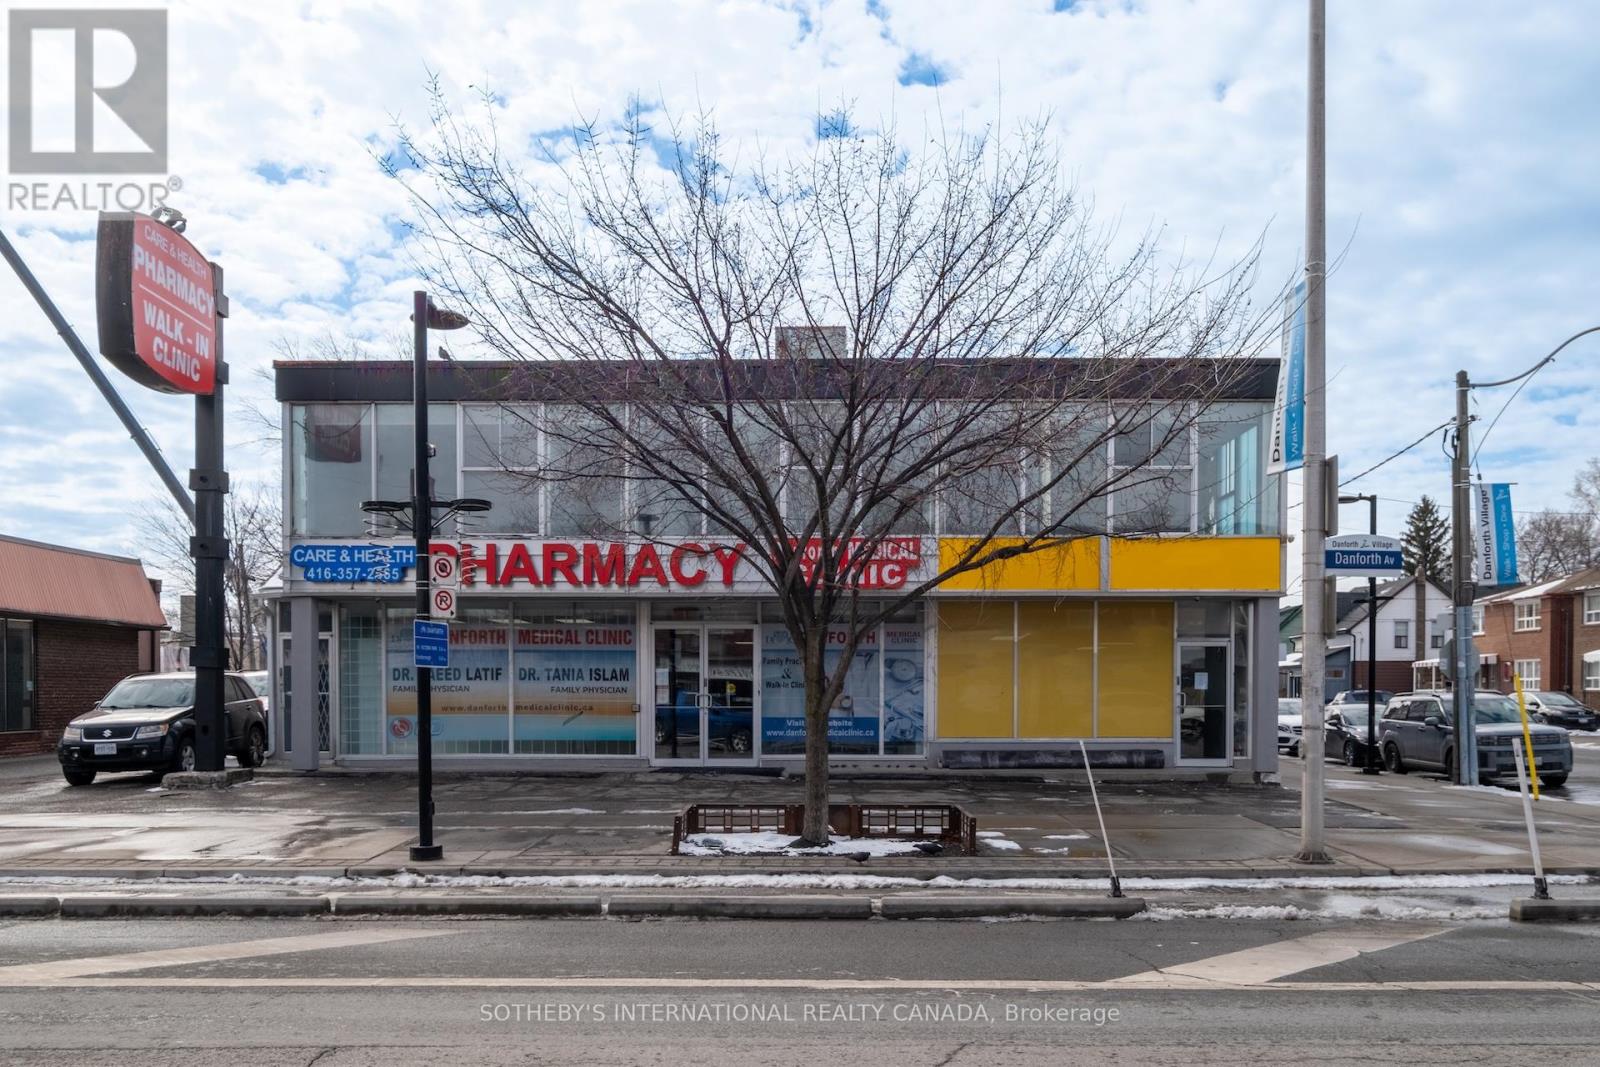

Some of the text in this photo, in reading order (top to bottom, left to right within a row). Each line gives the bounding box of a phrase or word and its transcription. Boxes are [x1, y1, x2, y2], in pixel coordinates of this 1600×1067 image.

[144, 225, 169, 253] CARE
[177, 248, 207, 280] HEALTH
[133, 243, 214, 318] PHARMACY
[143, 300, 184, 345] WALK
[195, 332, 208, 359] IN
[153, 336, 200, 382] CLINIC
[1481, 489, 1491, 527] Village
[1371, 541, 1393, 549] Village
[294, 549, 336, 563] CARE
[340, 549, 350, 563] &
[1335, 552, 1394, 565] Danforth Av
[1482, 530, 1492, 580] Danforth
[518, 629, 582, 645] MEDICAL
[586, 629, 632, 645] CLINIC
[392, 667, 503, 681] DR. AEED LATIF
[519, 668, 629, 681] DR. TANIA ISLAM
[781, 667, 792, 679] &
[550, 686, 628, 694] FAMILY PHYSICIAN
